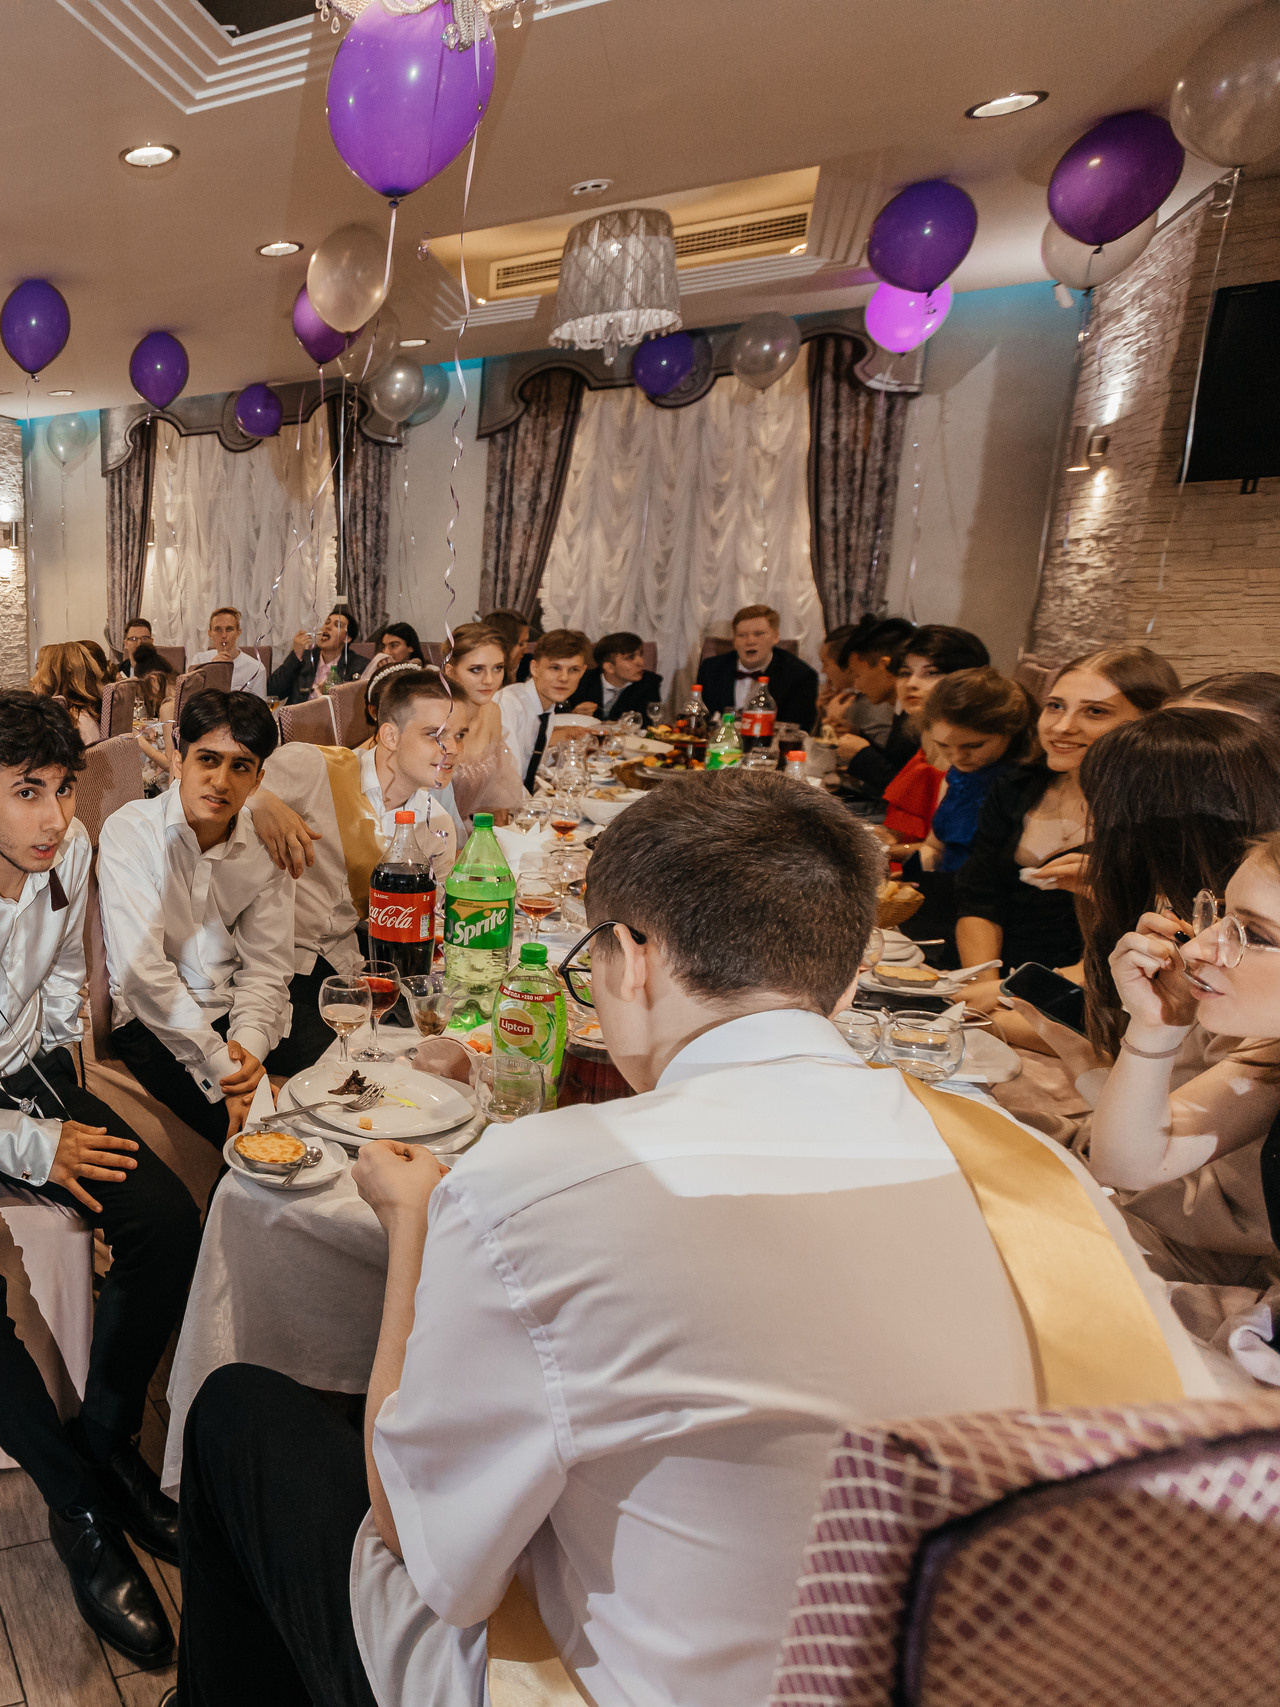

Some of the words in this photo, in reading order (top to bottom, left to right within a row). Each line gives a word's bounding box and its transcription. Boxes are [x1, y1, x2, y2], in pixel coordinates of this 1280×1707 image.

[370, 905, 418, 929] ca-Cola
[453, 908, 507, 946] Sprite
[501, 1019, 530, 1033] Lipton
